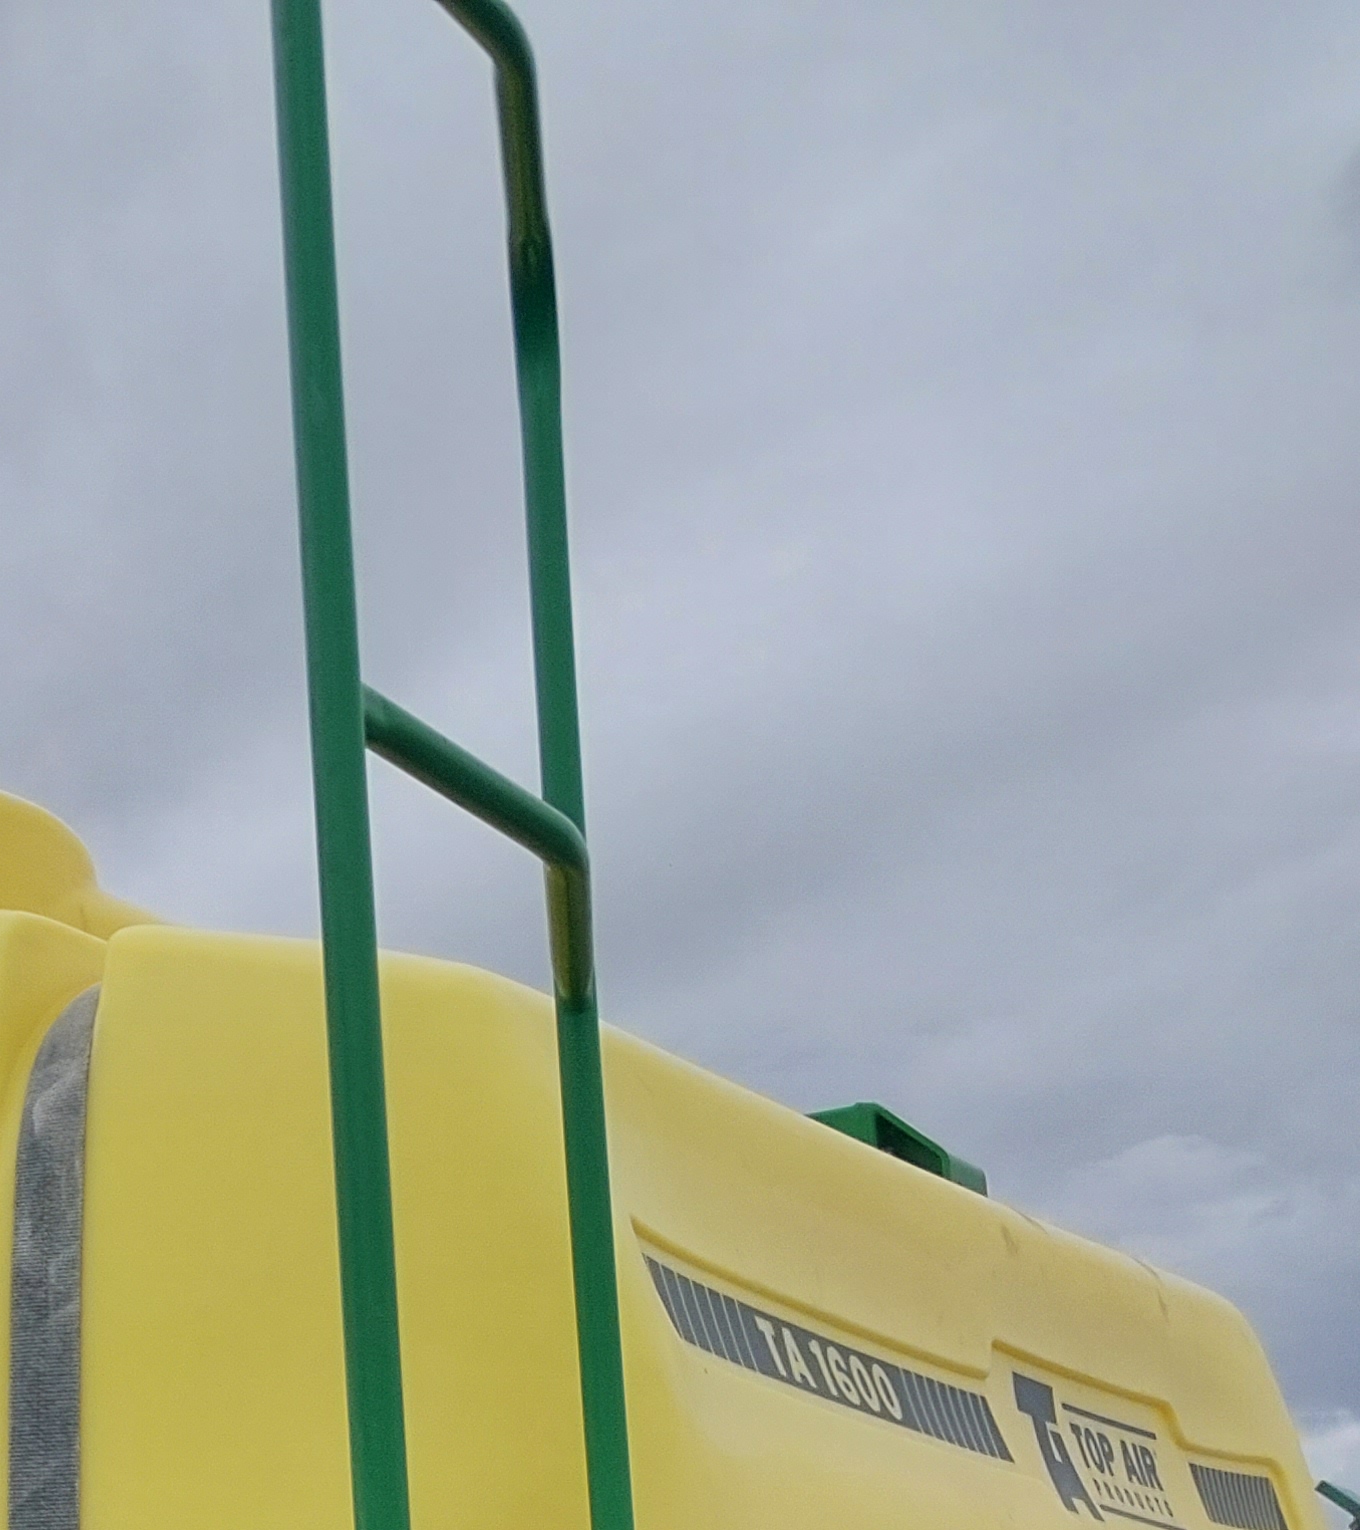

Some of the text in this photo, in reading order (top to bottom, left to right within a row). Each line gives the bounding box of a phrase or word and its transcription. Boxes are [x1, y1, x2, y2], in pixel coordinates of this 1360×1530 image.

[754, 1315, 903, 1420] TA 1600
[1069, 1422, 1165, 1492] TOP AIR
[1092, 1477, 1174, 1517] PRODUCTS
